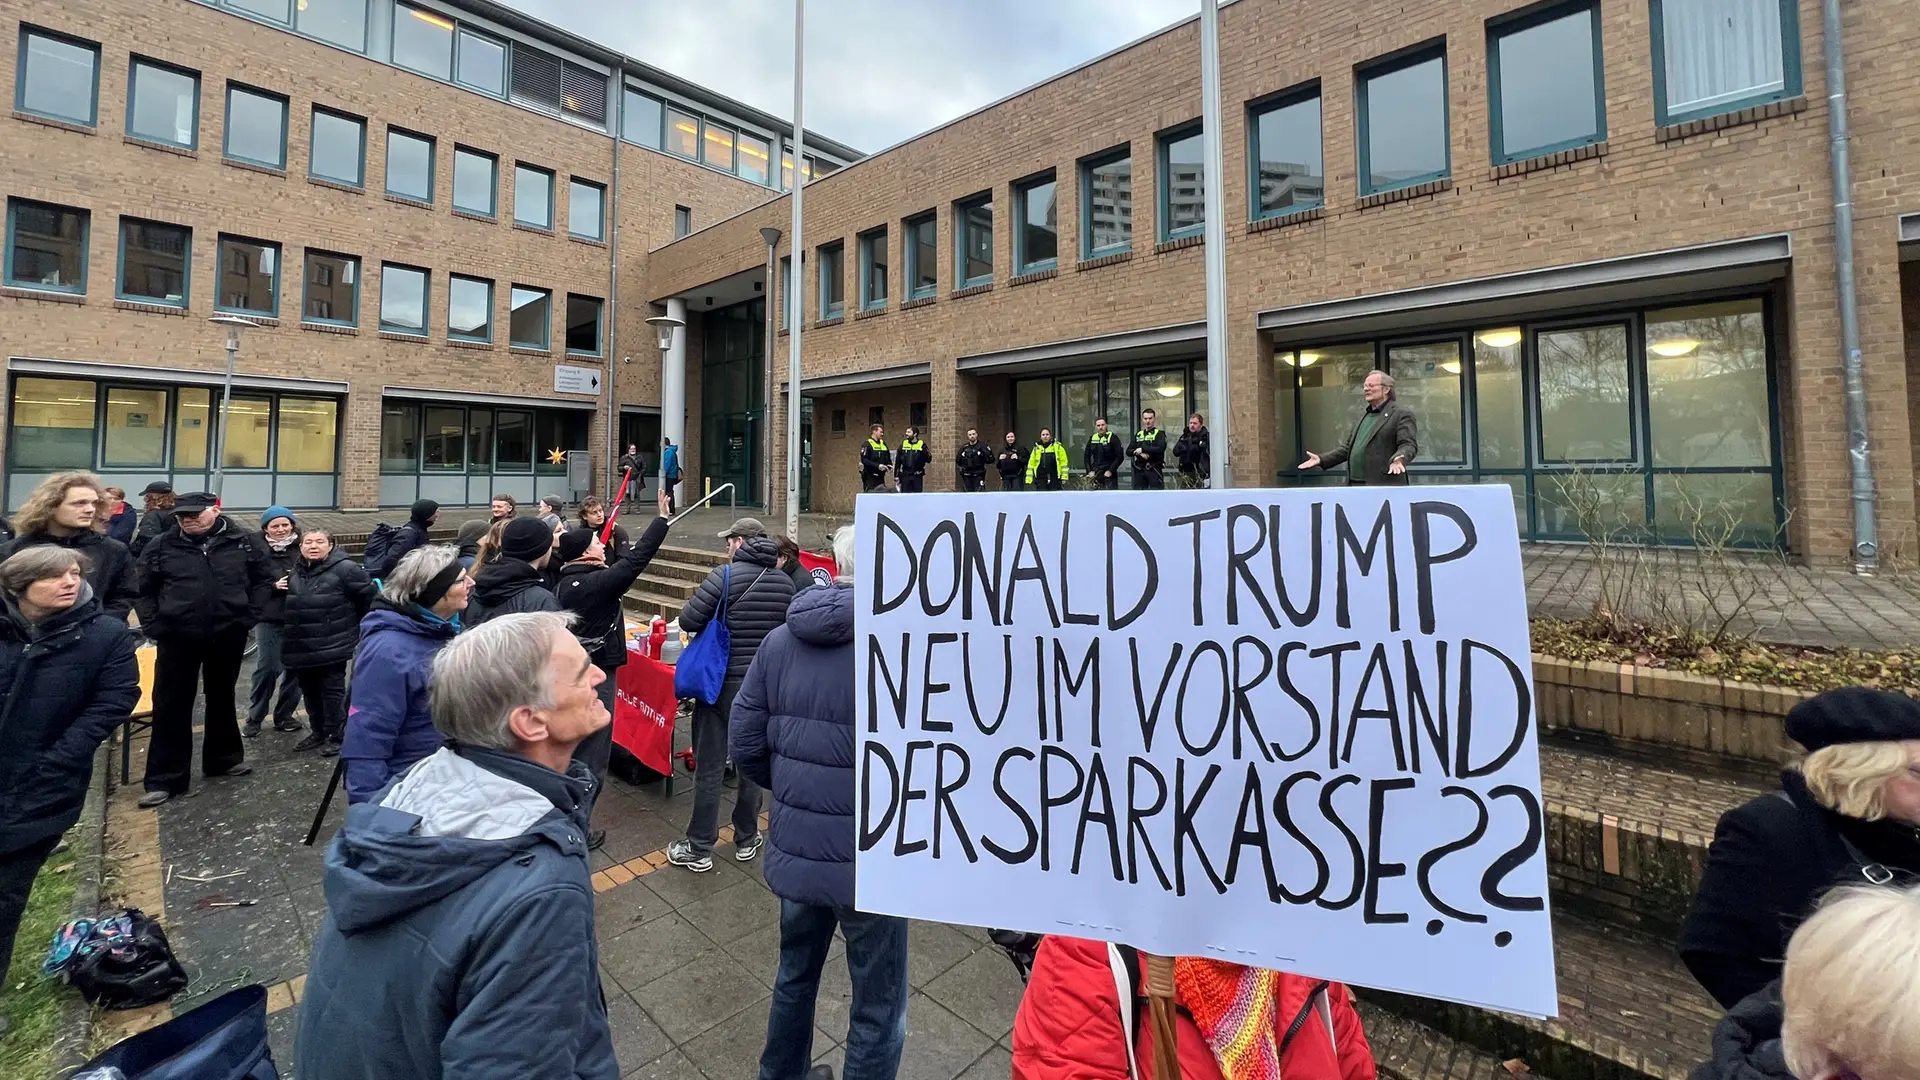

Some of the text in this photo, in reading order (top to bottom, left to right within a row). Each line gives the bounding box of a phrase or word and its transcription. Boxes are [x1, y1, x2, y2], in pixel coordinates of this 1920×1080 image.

[872, 499, 1478, 636] DONALD TRUMP
[617, 688, 666, 728] ALLE ANTIFA
[867, 631, 1531, 780] NEU IM VORSTAND
[858, 740, 1545, 948] DER SPARKASSE??
